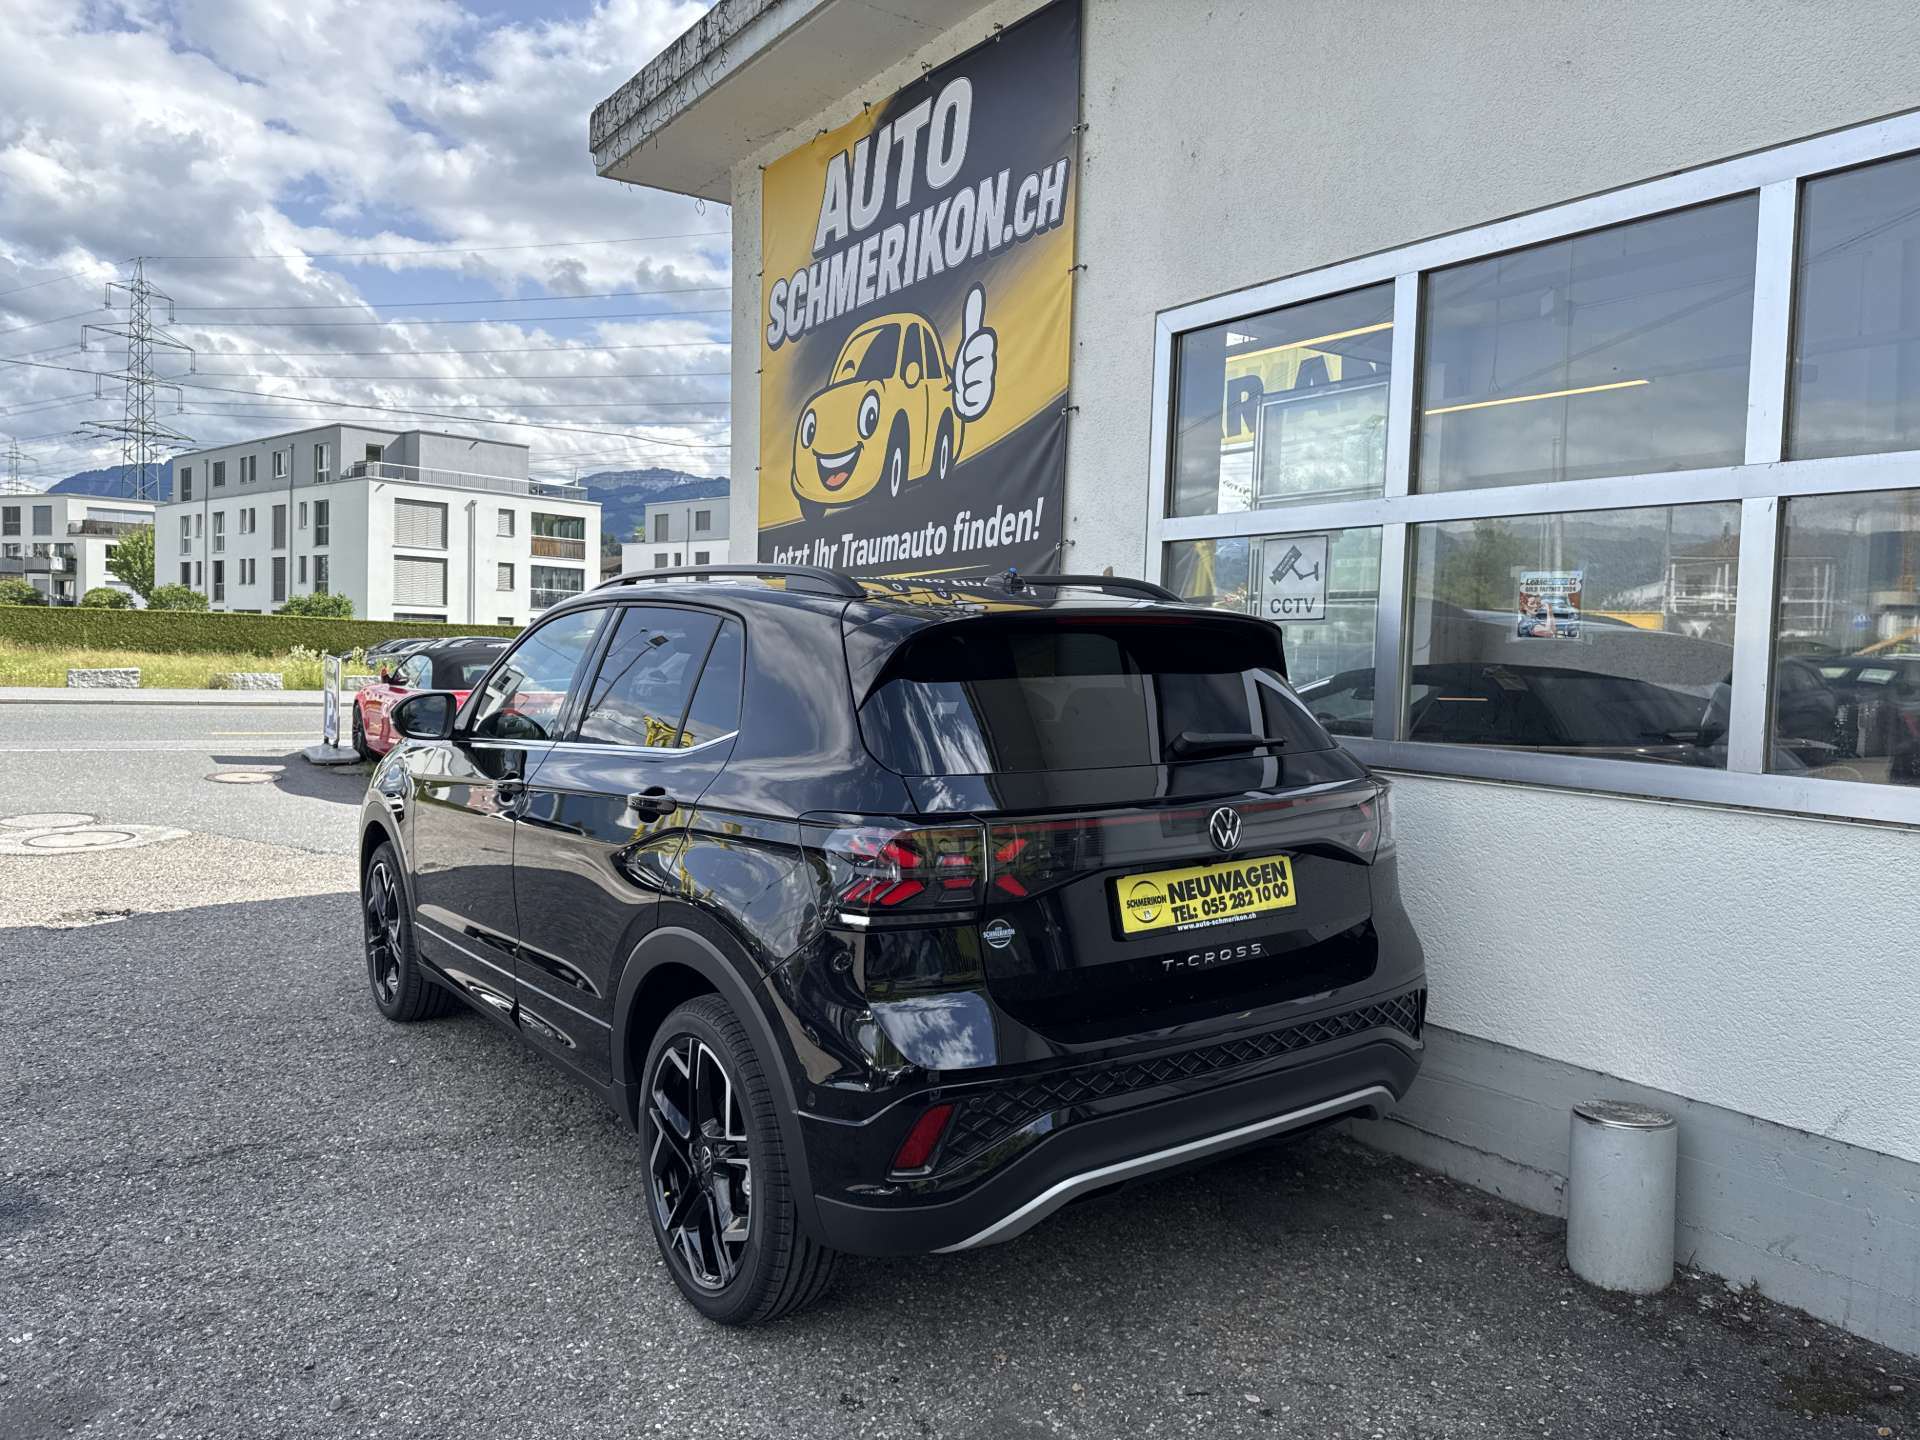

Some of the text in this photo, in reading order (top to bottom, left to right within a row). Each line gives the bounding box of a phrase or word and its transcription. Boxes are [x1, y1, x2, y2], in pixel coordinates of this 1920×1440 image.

[812, 76, 973, 251] AUTO
[766, 157, 1069, 346] SCHMERIKON.CH
[813, 537, 839, 569] Ihr
[841, 520, 948, 569] Traumauto
[952, 496, 1045, 553] finden!
[1270, 597, 1316, 614] CCTV
[1126, 894, 1167, 909] SCHMERIKON
[1167, 860, 1288, 905] NEUWAGEN
[1171, 881, 1289, 924] TEL: 055 282 10 00
[1178, 913, 1257, 931] www.auto-schmerikon.ch
[1162, 943, 1262, 973] T-CROSS
